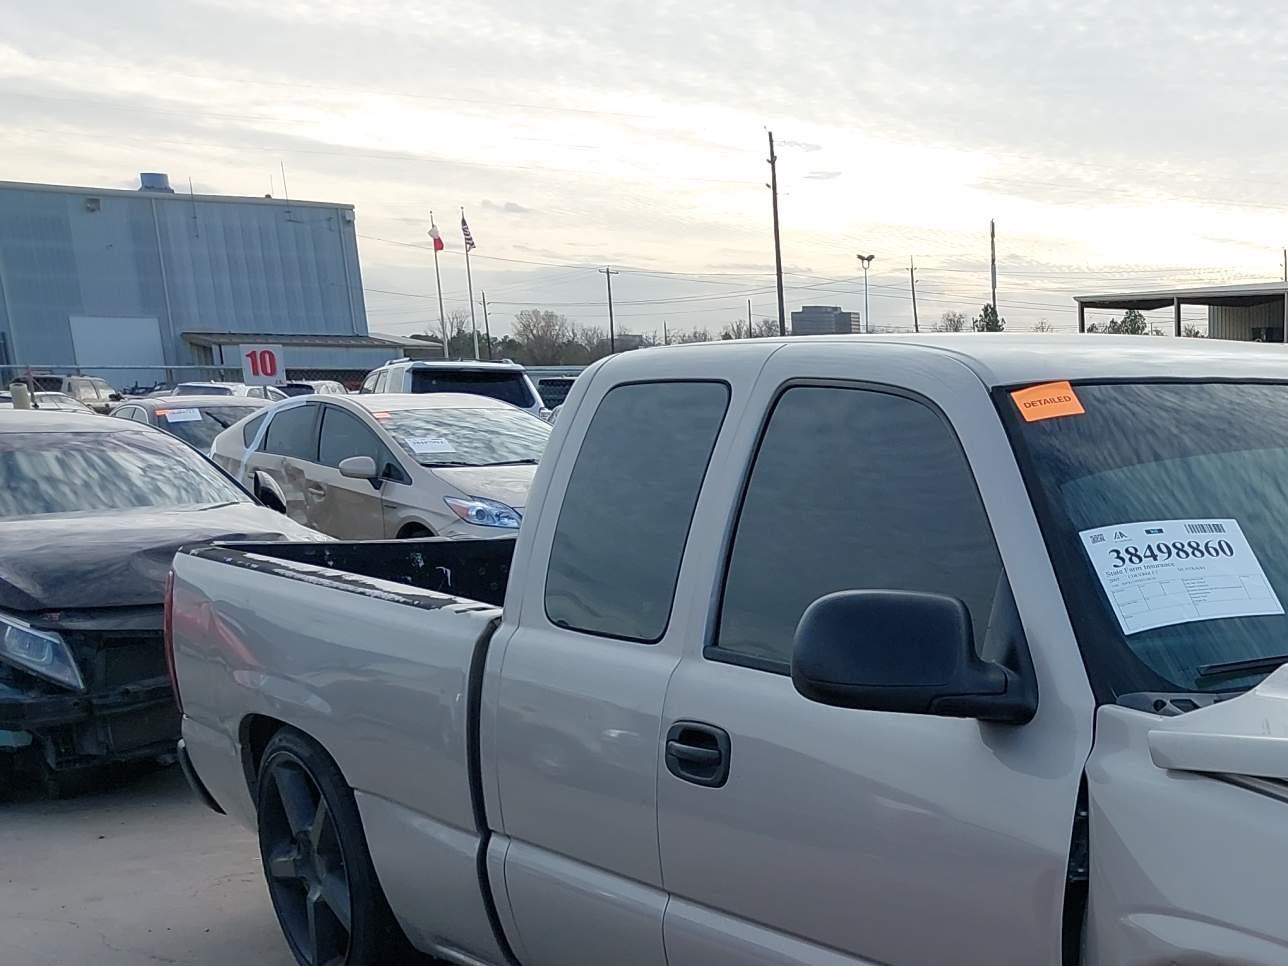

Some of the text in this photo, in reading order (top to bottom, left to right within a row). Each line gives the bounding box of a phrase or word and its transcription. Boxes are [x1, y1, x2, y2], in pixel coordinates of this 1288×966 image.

[245, 350, 277, 376] 10
[1023, 395, 1073, 409] DETAILED
[1108, 539, 1235, 568] 38498860
